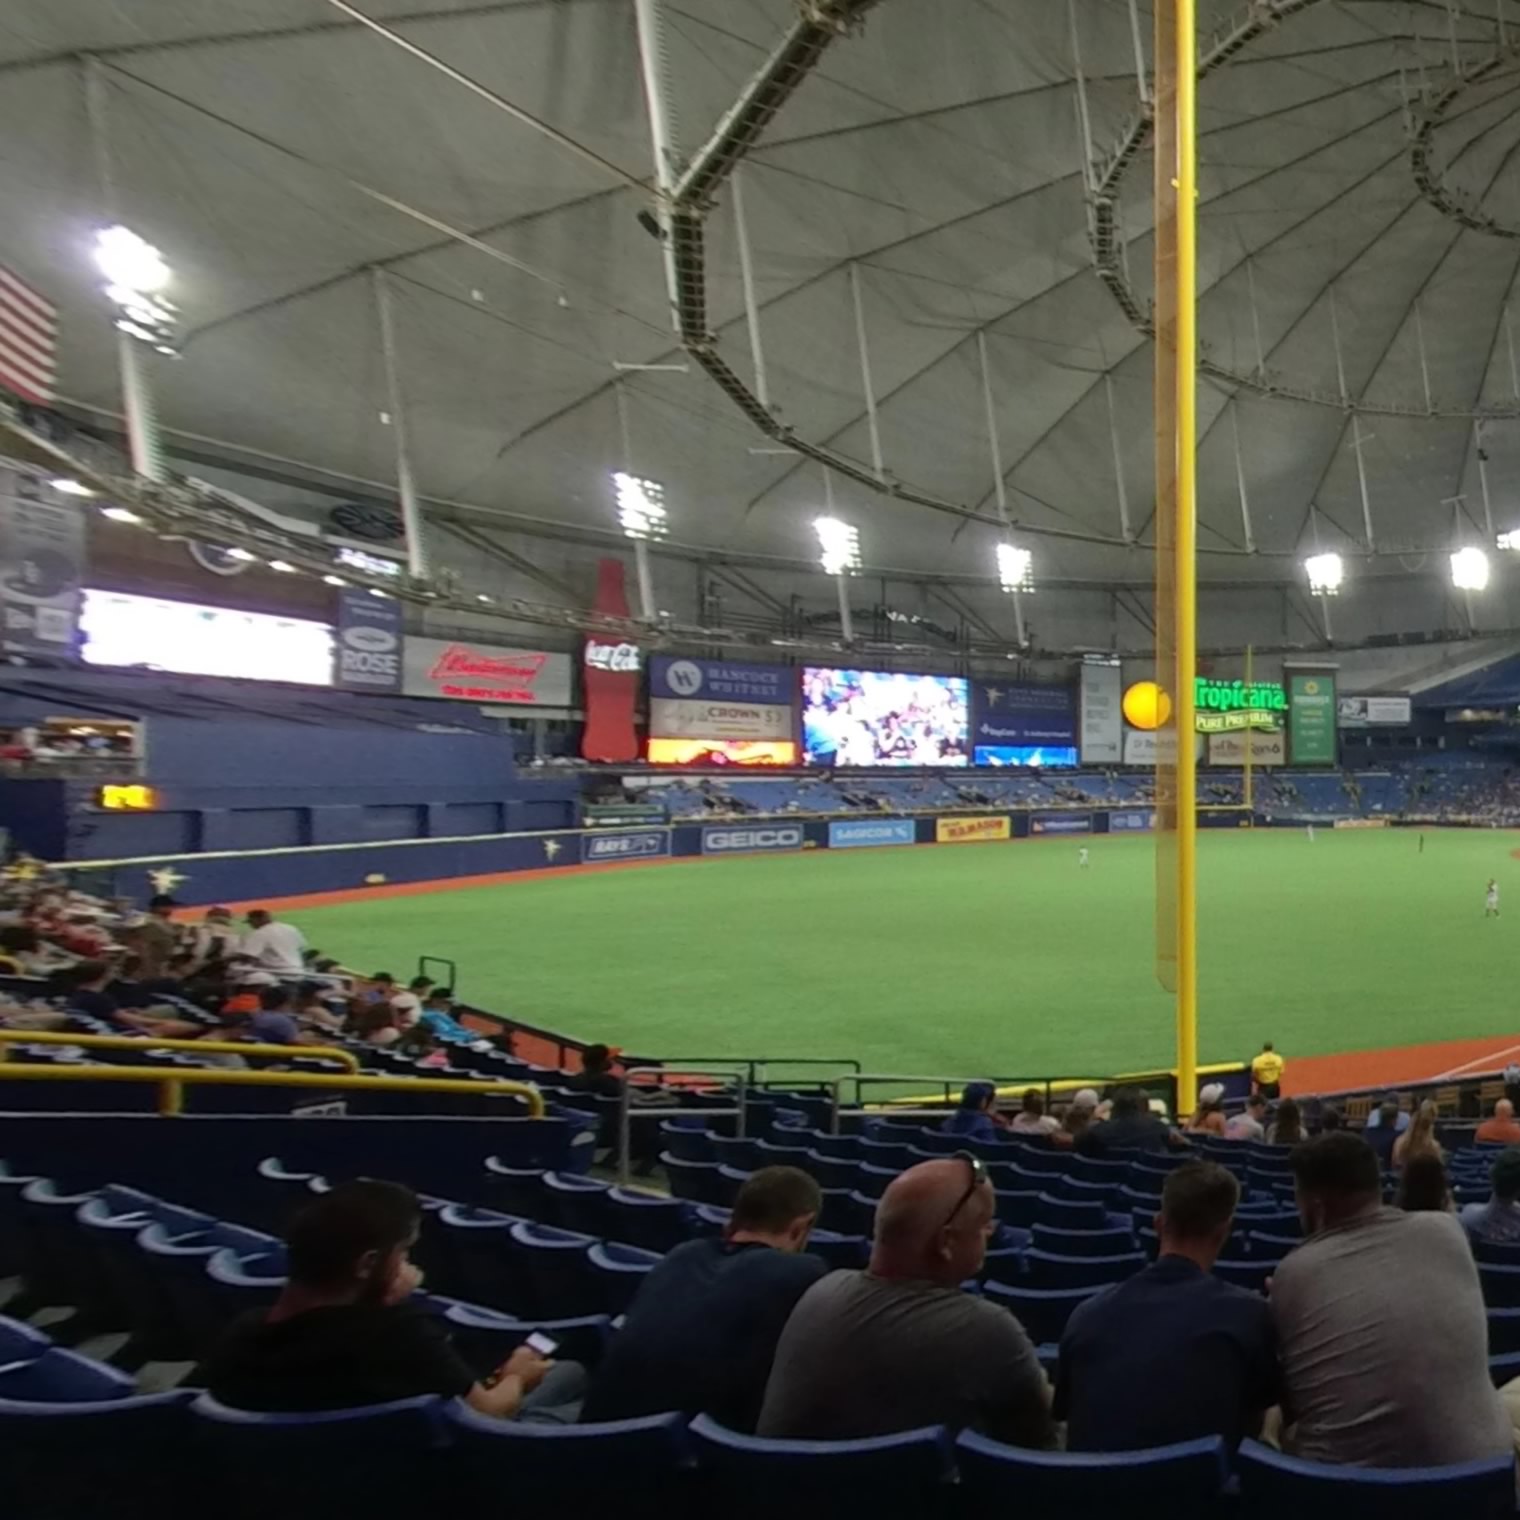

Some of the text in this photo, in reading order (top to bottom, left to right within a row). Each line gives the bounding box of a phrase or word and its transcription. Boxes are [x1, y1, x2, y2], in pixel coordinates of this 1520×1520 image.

[342, 651, 399, 675] ROSE
[708, 668, 778, 683] HANCOCK
[708, 682, 777, 696] WHITNEY
[1194, 677, 1286, 711] Tropicana
[707, 706, 760, 719] CROWN
[1196, 713, 1223, 729] PURE
[706, 829, 800, 849] GEICO
